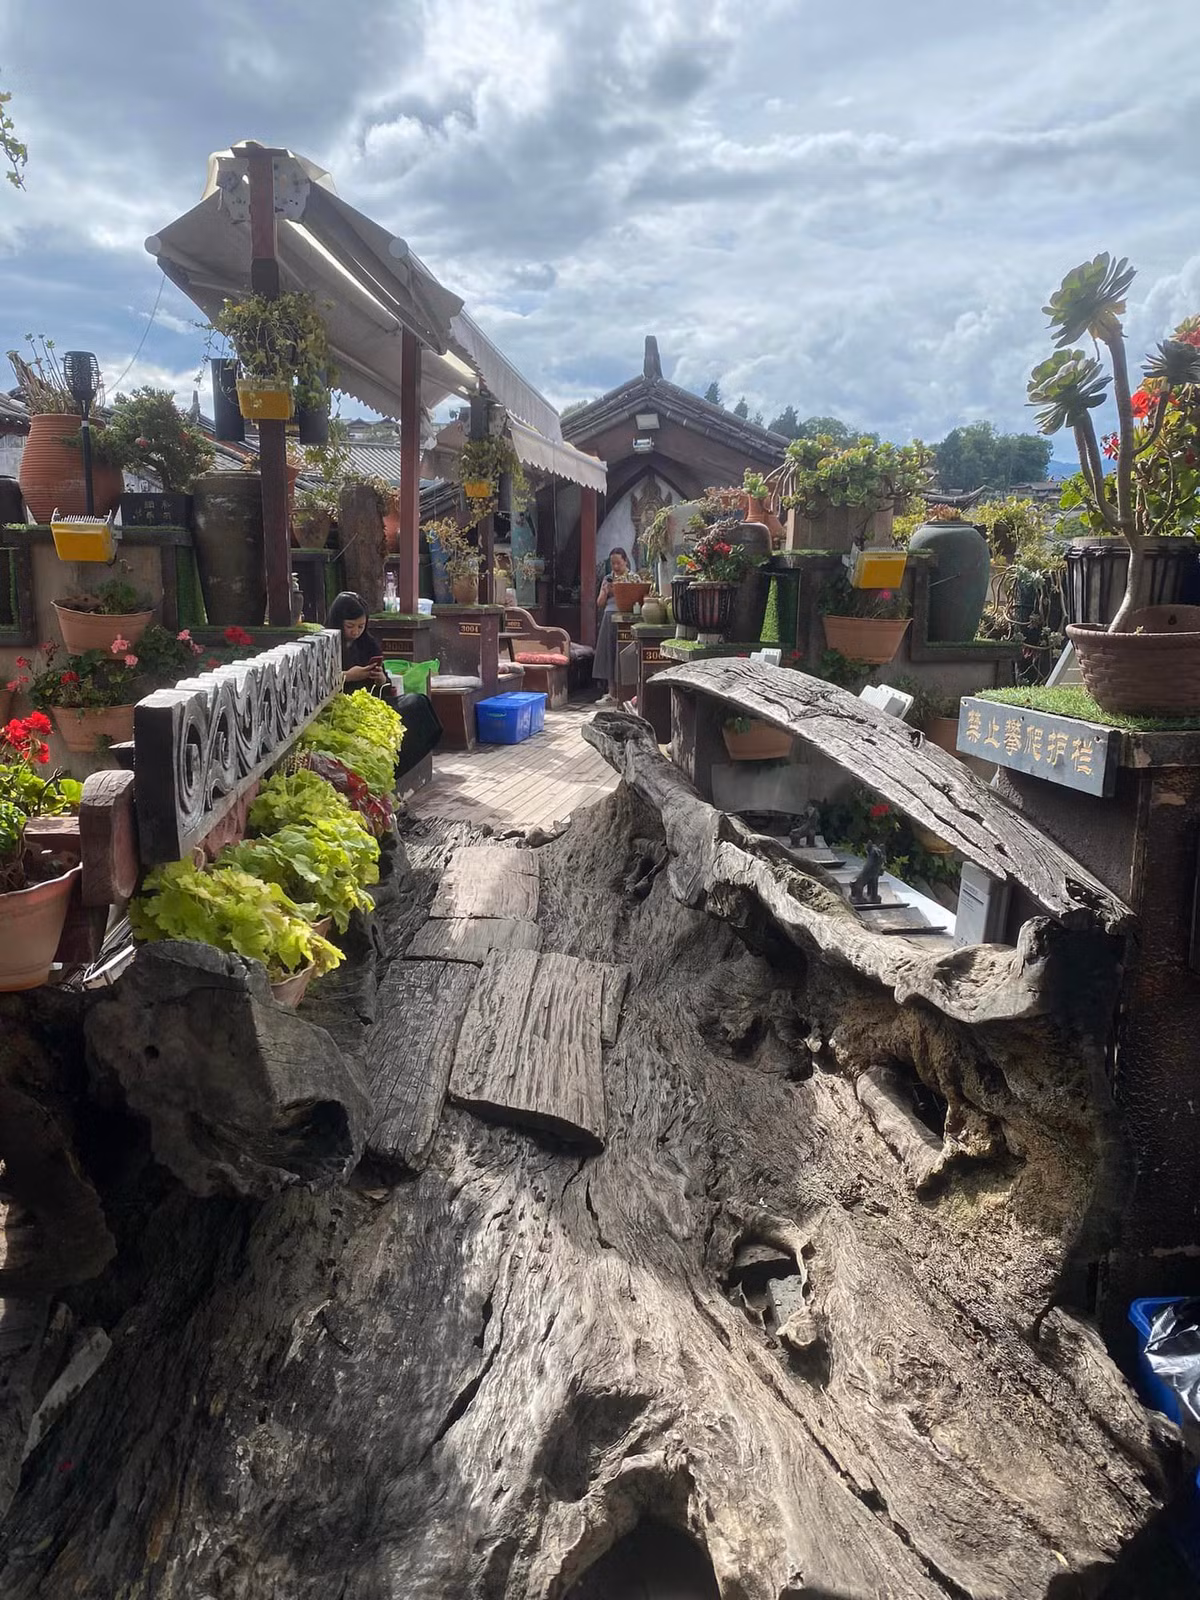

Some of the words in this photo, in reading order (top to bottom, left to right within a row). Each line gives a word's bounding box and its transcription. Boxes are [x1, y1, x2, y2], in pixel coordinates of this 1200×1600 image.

[966, 709, 1093, 775] 禁止攀爬护栏
